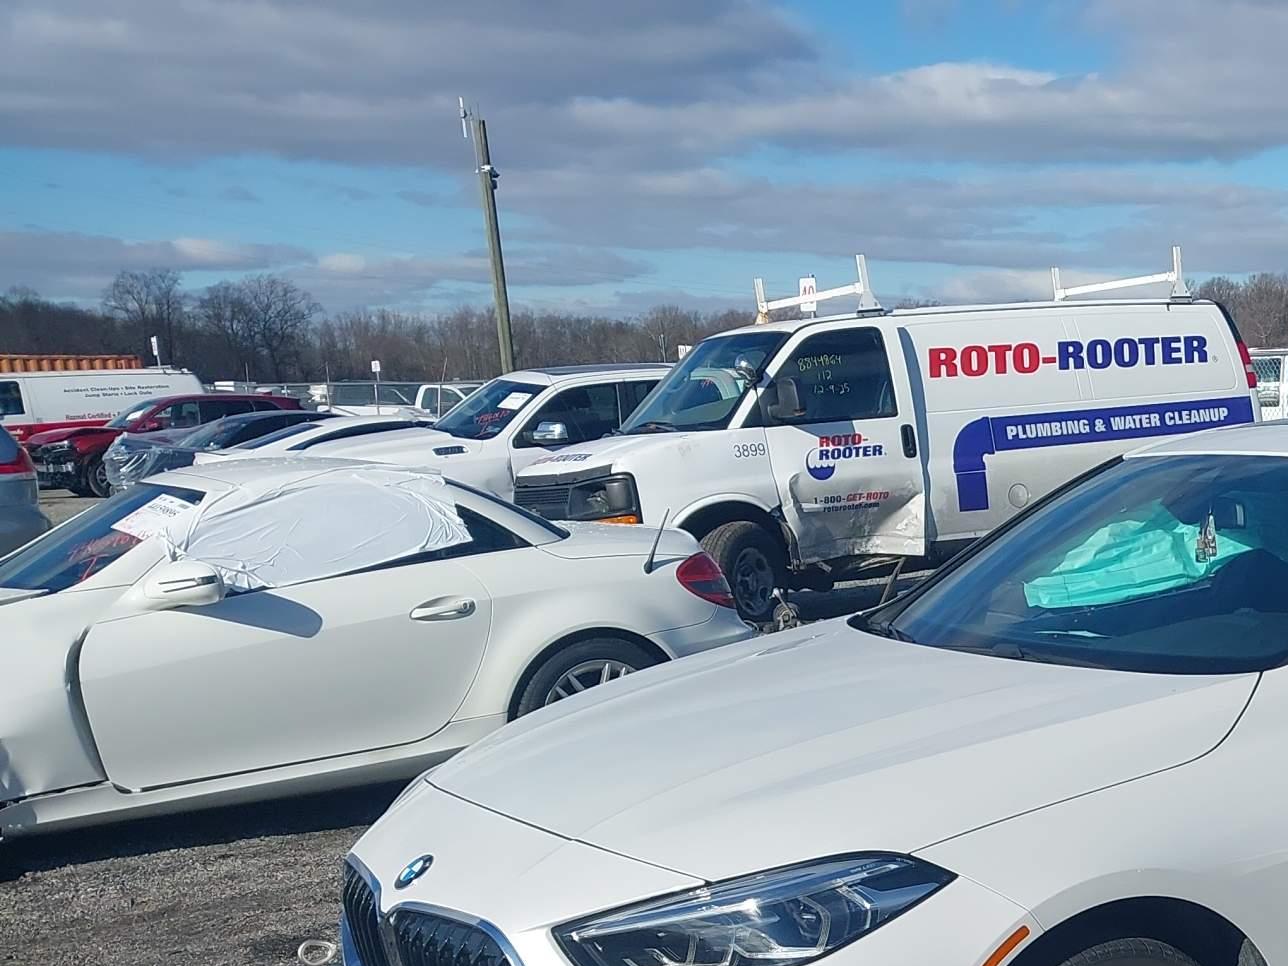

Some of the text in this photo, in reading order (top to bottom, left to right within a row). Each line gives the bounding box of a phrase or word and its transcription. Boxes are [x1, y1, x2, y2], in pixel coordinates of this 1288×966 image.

[928, 335, 1209, 378] ROTO-ROOTER
[1006, 407, 1229, 440] PLUMBING & WATER CLEANUP
[818, 433, 869, 448] ROTO-
[733, 442, 767, 459] 3899
[818, 445, 883, 461] ROOTER
